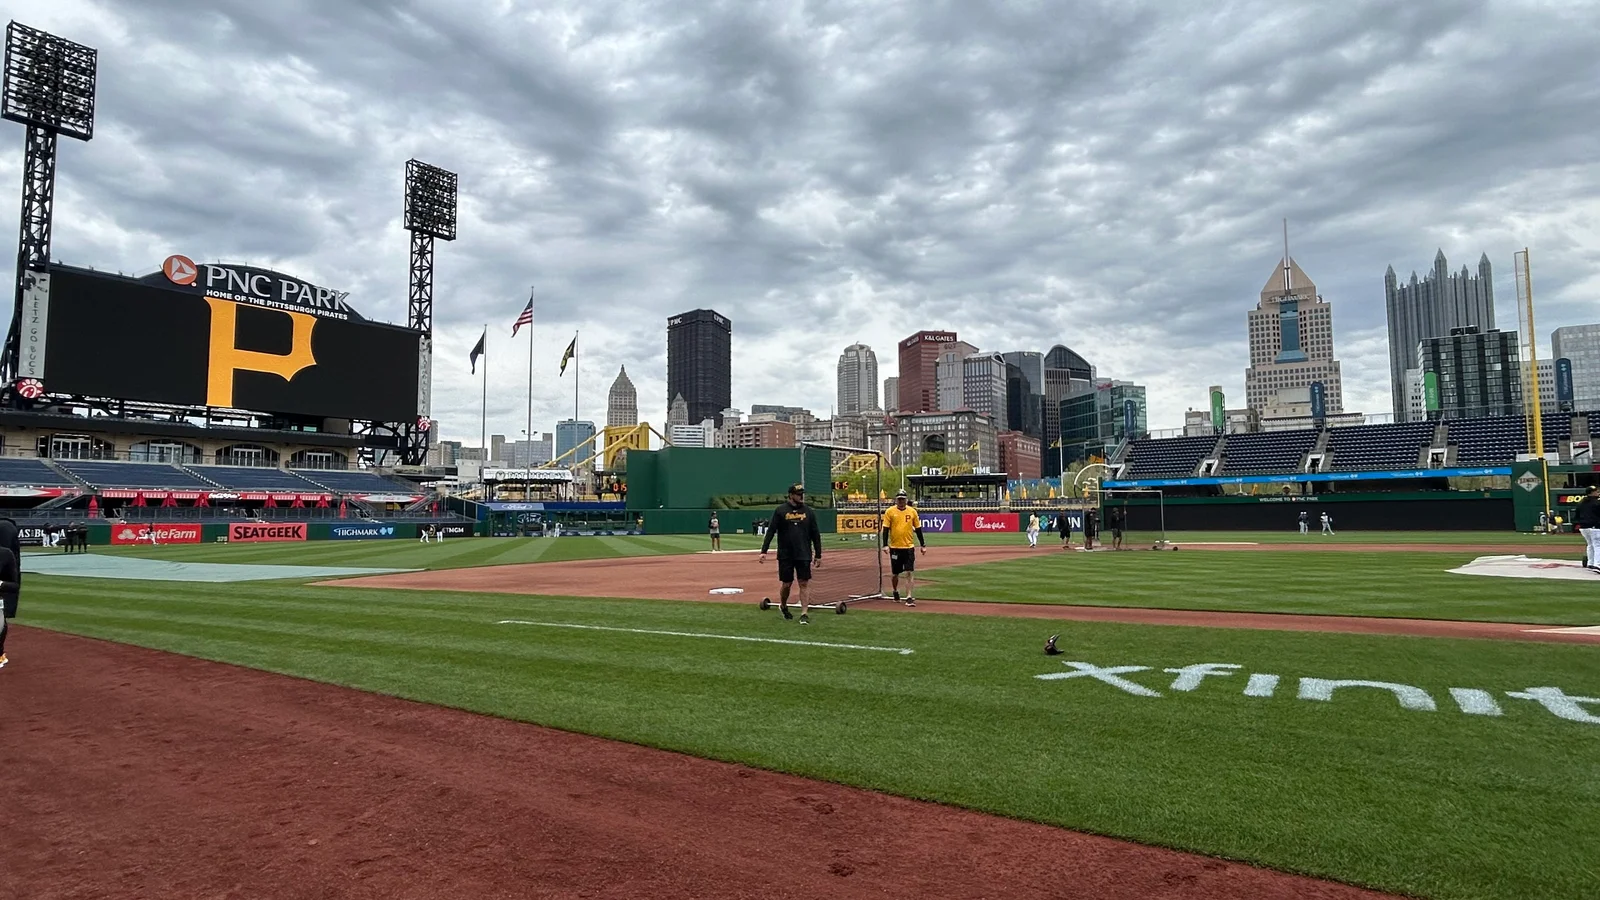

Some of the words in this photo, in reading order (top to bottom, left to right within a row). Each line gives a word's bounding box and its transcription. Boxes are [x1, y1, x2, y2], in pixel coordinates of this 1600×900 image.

[204, 264, 271, 297] PNC
[278, 278, 350, 312] PARK
[206, 289, 232, 300] HOME
[234, 294, 247, 302] OF
[248, 297, 266, 306] THE
[266, 300, 316, 315] PITTSBURGH
[317, 309, 348, 320] PIRATES
[203, 297, 318, 407] P
[972, 466, 990, 474] TIME
[905, 514, 911, 522] P
[234, 526, 302, 540] SEATGEEK
[334, 526, 378, 536] HIGHMARK
